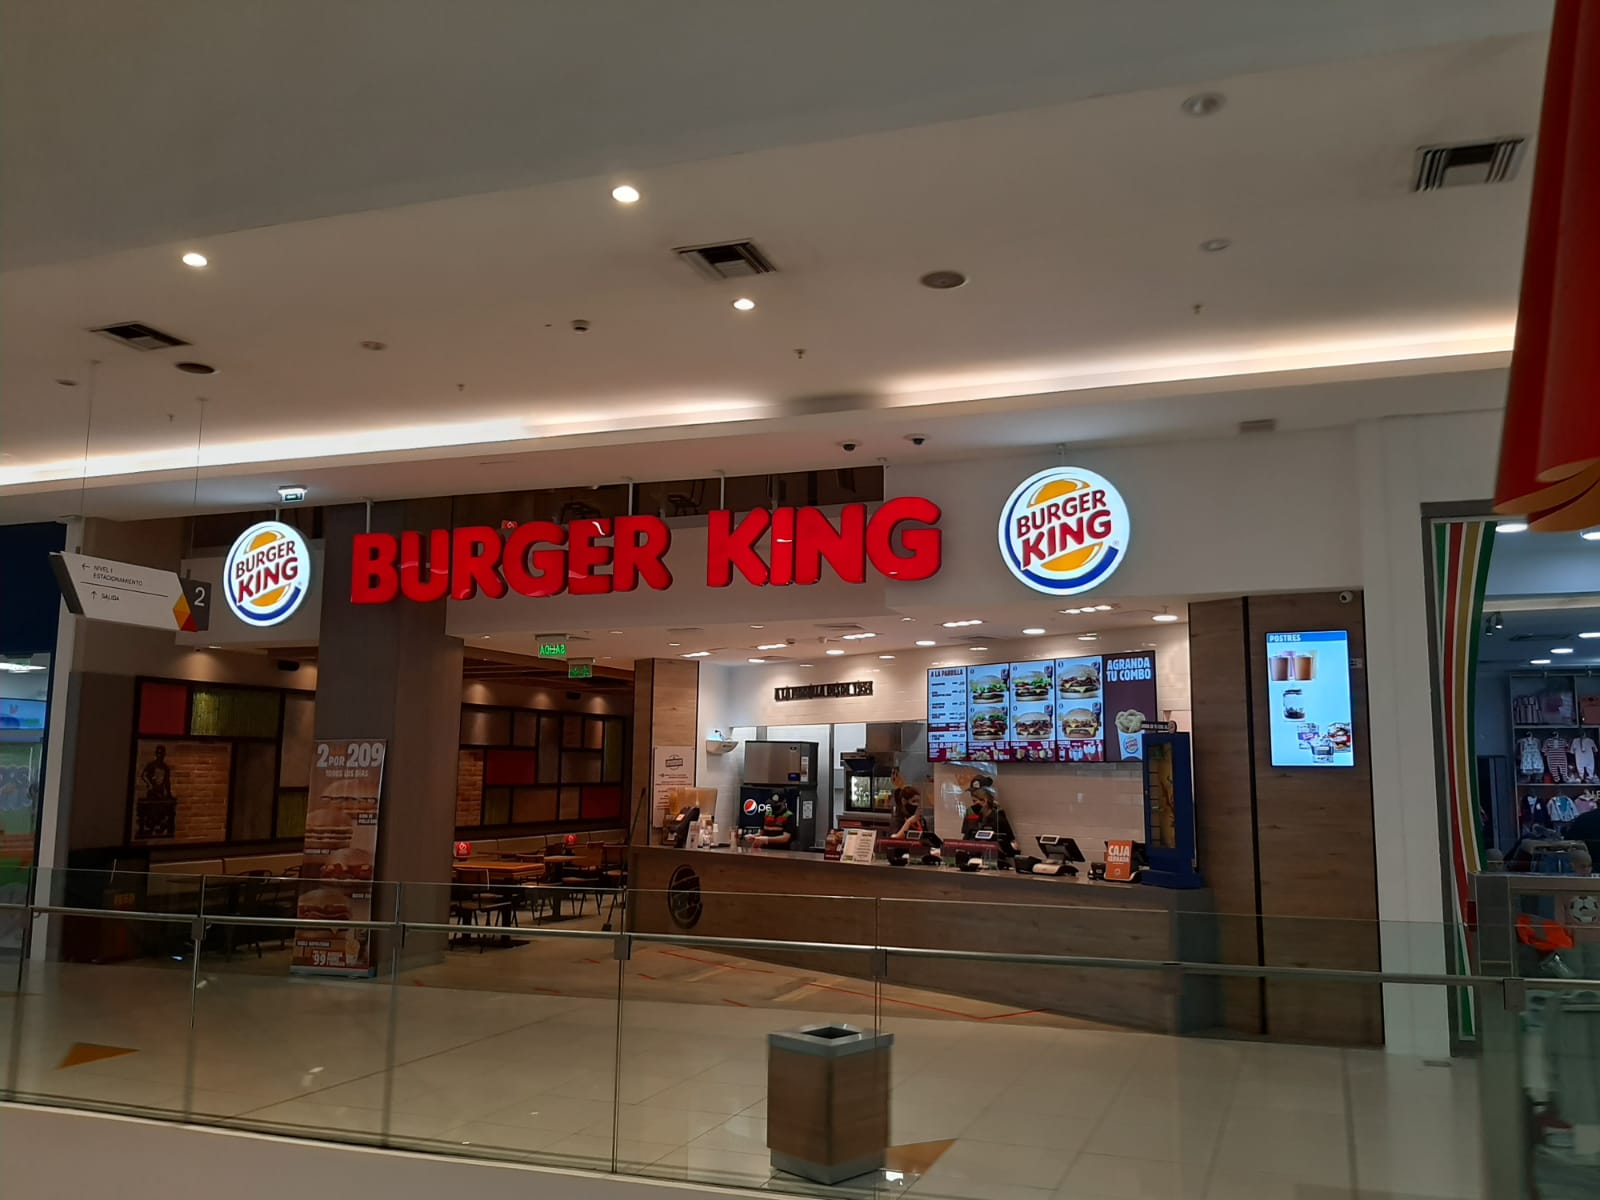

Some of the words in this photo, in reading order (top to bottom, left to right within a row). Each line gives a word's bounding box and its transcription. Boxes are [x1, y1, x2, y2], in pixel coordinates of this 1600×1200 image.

[1016, 489, 1107, 539] BURGER
[350, 514, 673, 604] BURGER
[706, 496, 942, 587] KING
[1022, 509, 1111, 568] KING
[236, 540, 296, 579] BURGER
[238, 557, 298, 603] KING
[194, 586, 206, 607] 2
[1269, 634, 1301, 642] POSTRES
[1106, 670, 1117, 682] TU
[1120, 669, 1152, 681] COMBO
[1107, 657, 1151, 671] AGRANDA
[316, 743, 329, 767] 2
[328, 755, 345, 767] POR
[346, 742, 384, 767] 209
[1109, 845, 1130, 857] CAJA
